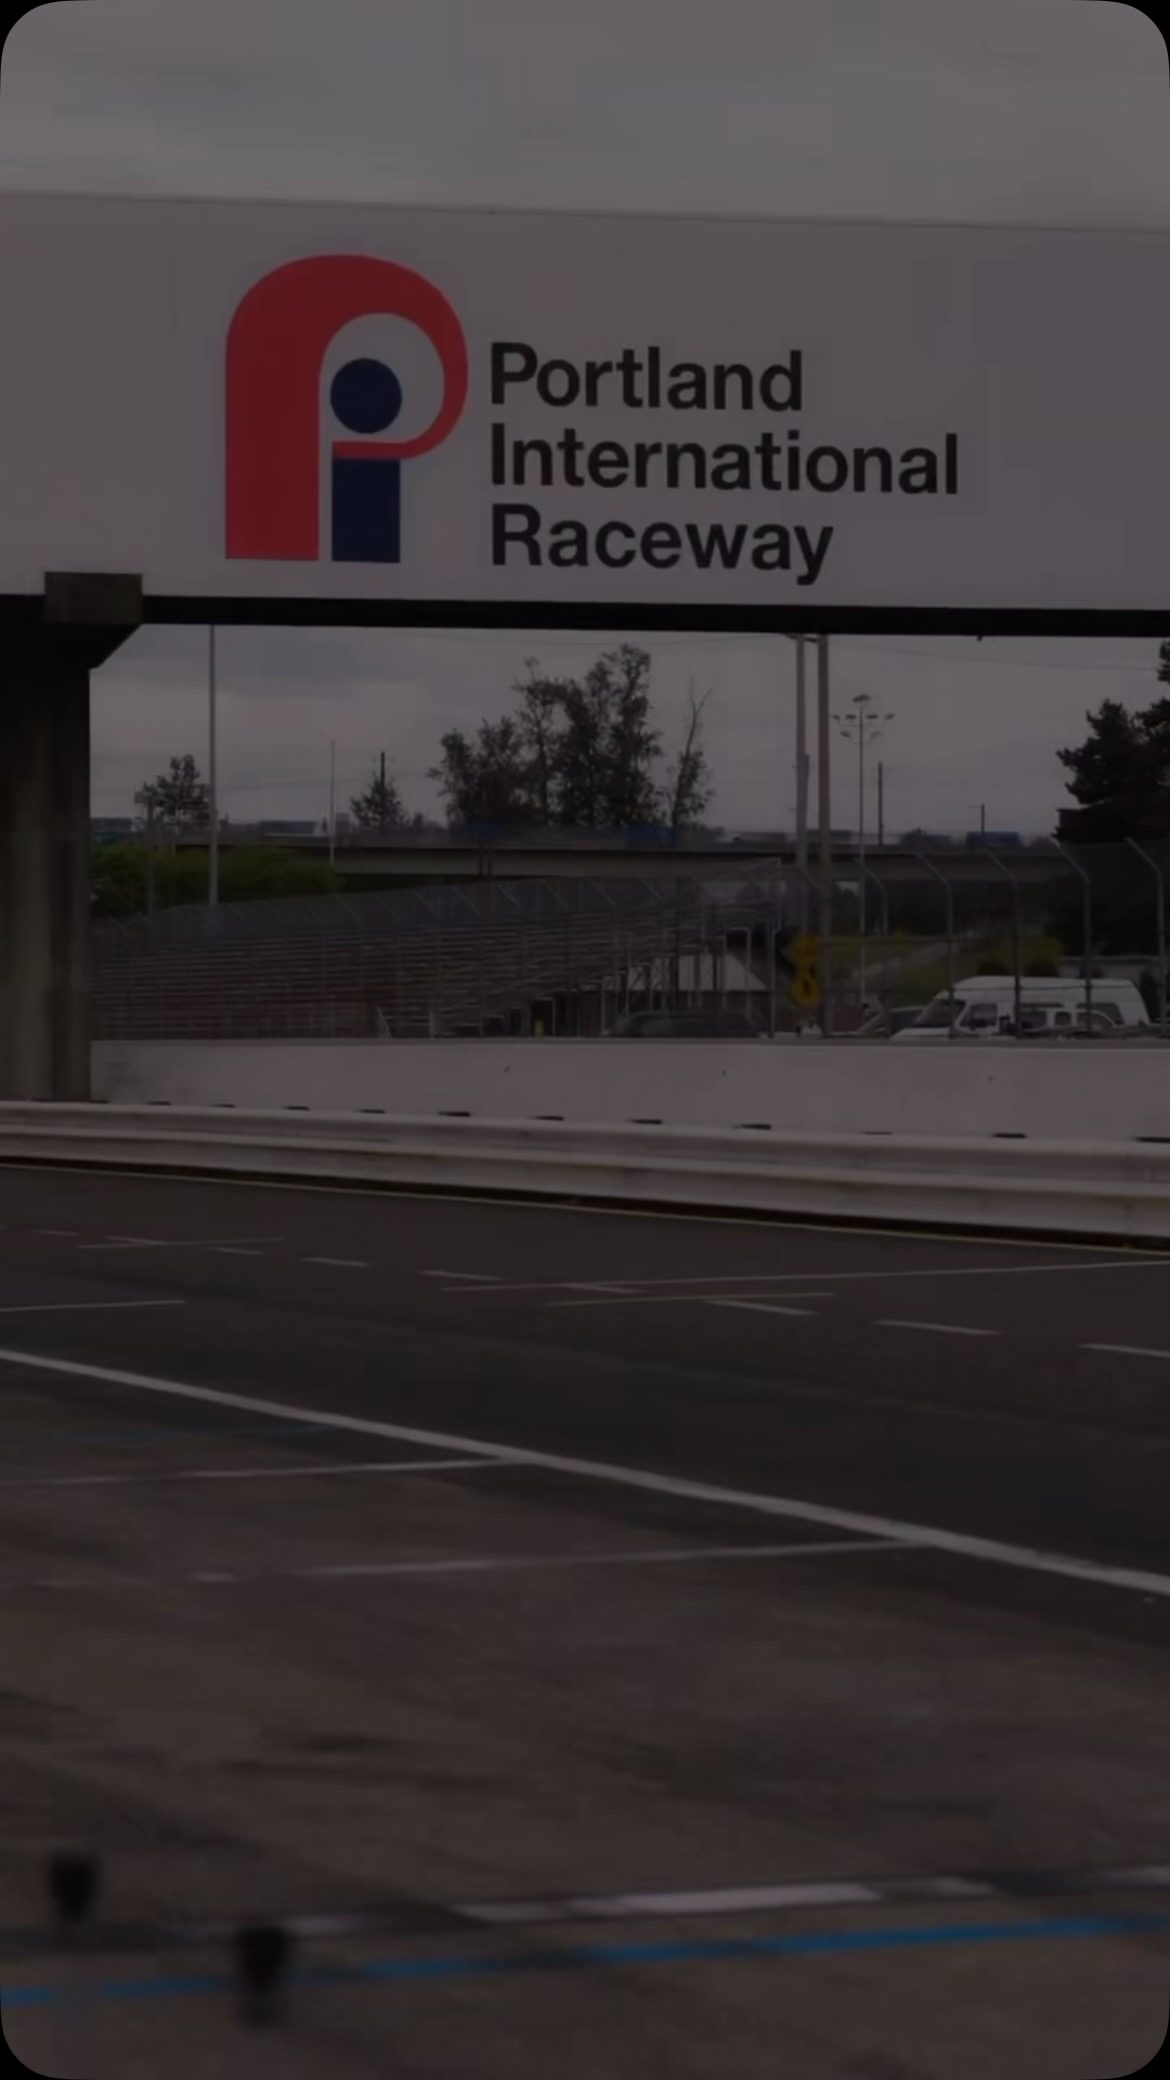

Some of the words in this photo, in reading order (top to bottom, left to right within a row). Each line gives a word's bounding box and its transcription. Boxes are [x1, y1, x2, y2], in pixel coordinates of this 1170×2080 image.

[490, 341, 803, 412] Portland
[490, 422, 959, 495] International
[490, 503, 835, 586] Raceway
